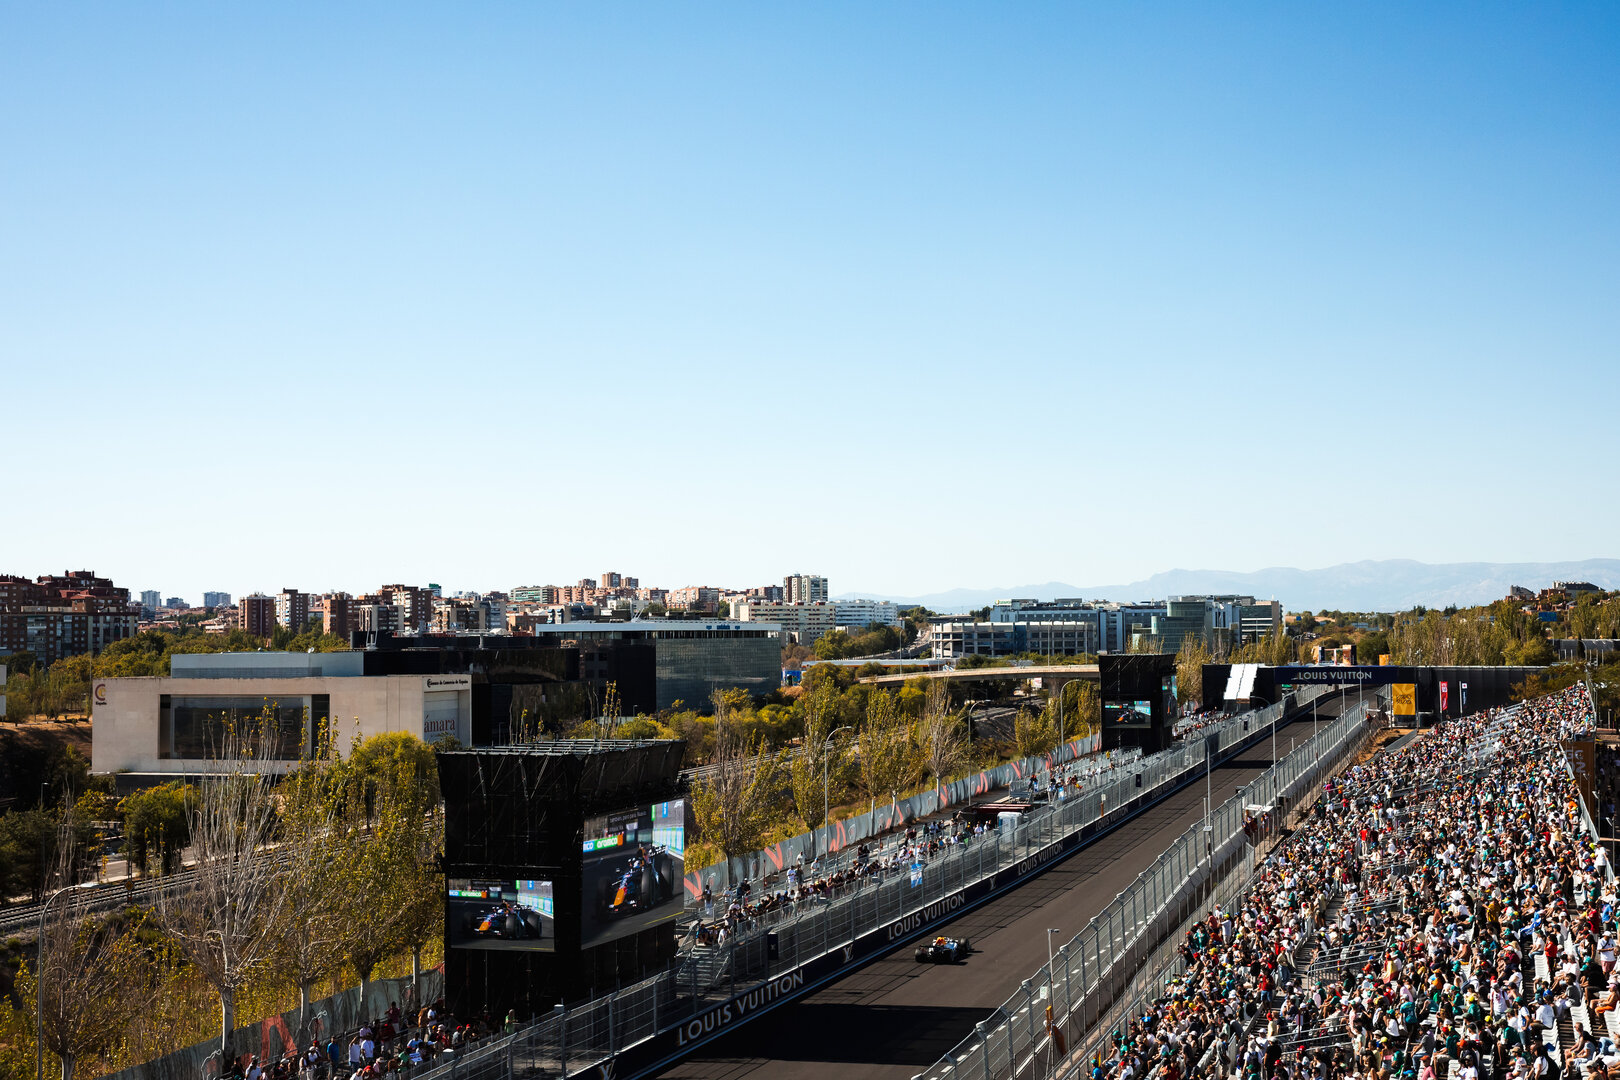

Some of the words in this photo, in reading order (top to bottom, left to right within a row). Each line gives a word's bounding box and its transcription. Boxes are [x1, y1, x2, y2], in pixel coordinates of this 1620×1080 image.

[1298, 671, 1327, 680] LOUIS
[1330, 671, 1372, 680] VUITTON
[597, 837, 617, 849] aramco
[1018, 854, 1037, 875] LOUIS
[1040, 841, 1063, 862] VUITTON
[888, 912, 921, 941] LOUIS
[924, 892, 965, 922] VUITTON
[679, 1004, 732, 1046] LOUIS
[737, 969, 803, 1015] VUITTON
